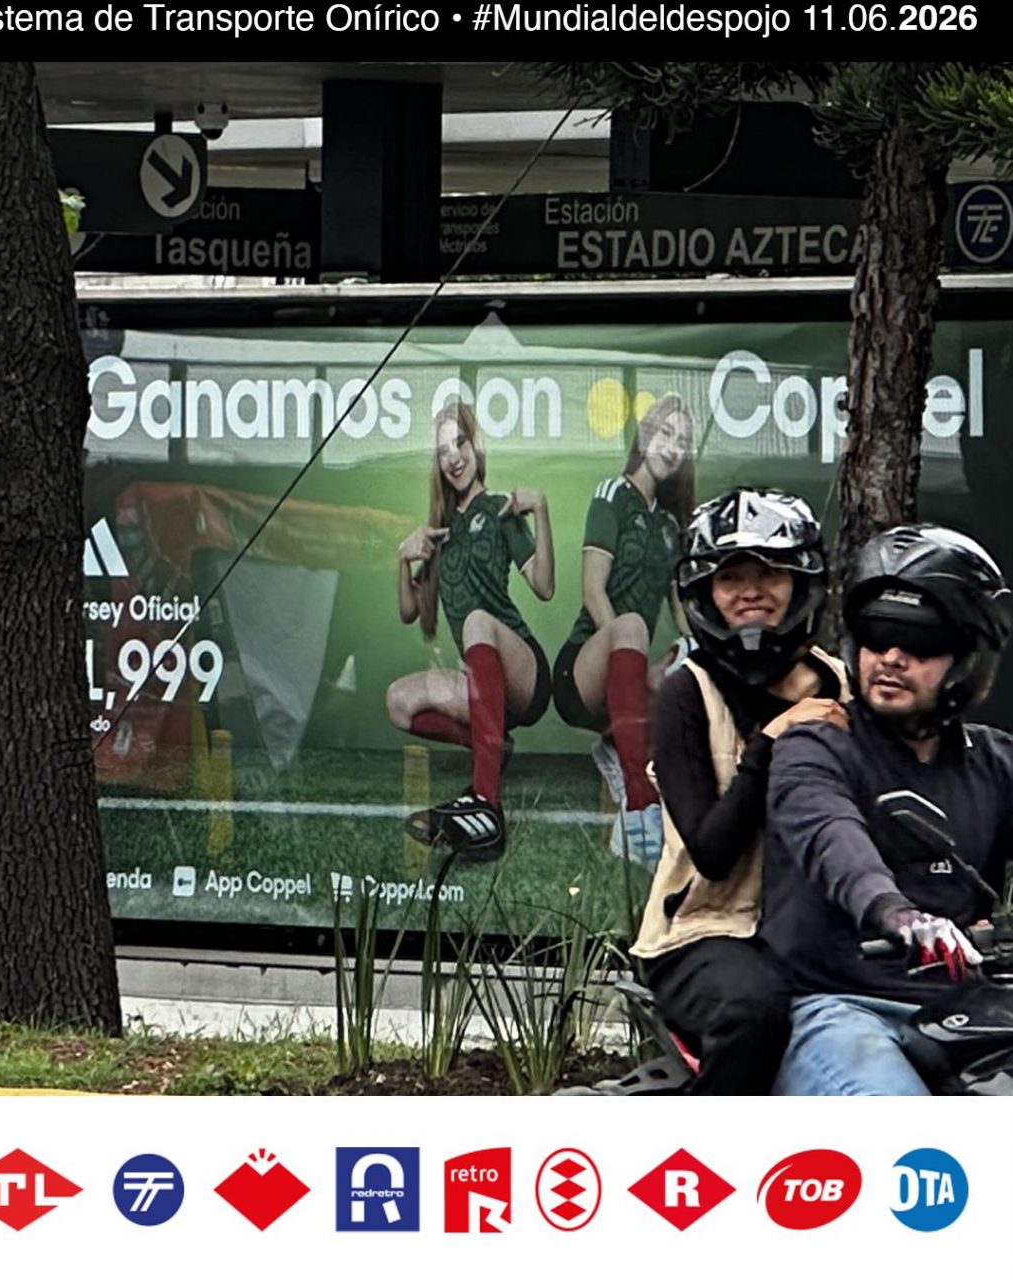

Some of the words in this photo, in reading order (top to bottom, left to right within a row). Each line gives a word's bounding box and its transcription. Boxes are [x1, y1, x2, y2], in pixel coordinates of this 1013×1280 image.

[193, 196, 241, 221] ción
[439, 202, 479, 217] ervicio
[545, 197, 640, 225] Estación
[557, 227, 716, 269] ESTADIO
[87, 354, 412, 440] Ganamos
[708, 348, 984, 463] Copel
[82, 600, 124, 629] rsey
[106, 867, 152, 890] enda
[204, 870, 243, 898] App
[246, 870, 312, 900] Coppel
